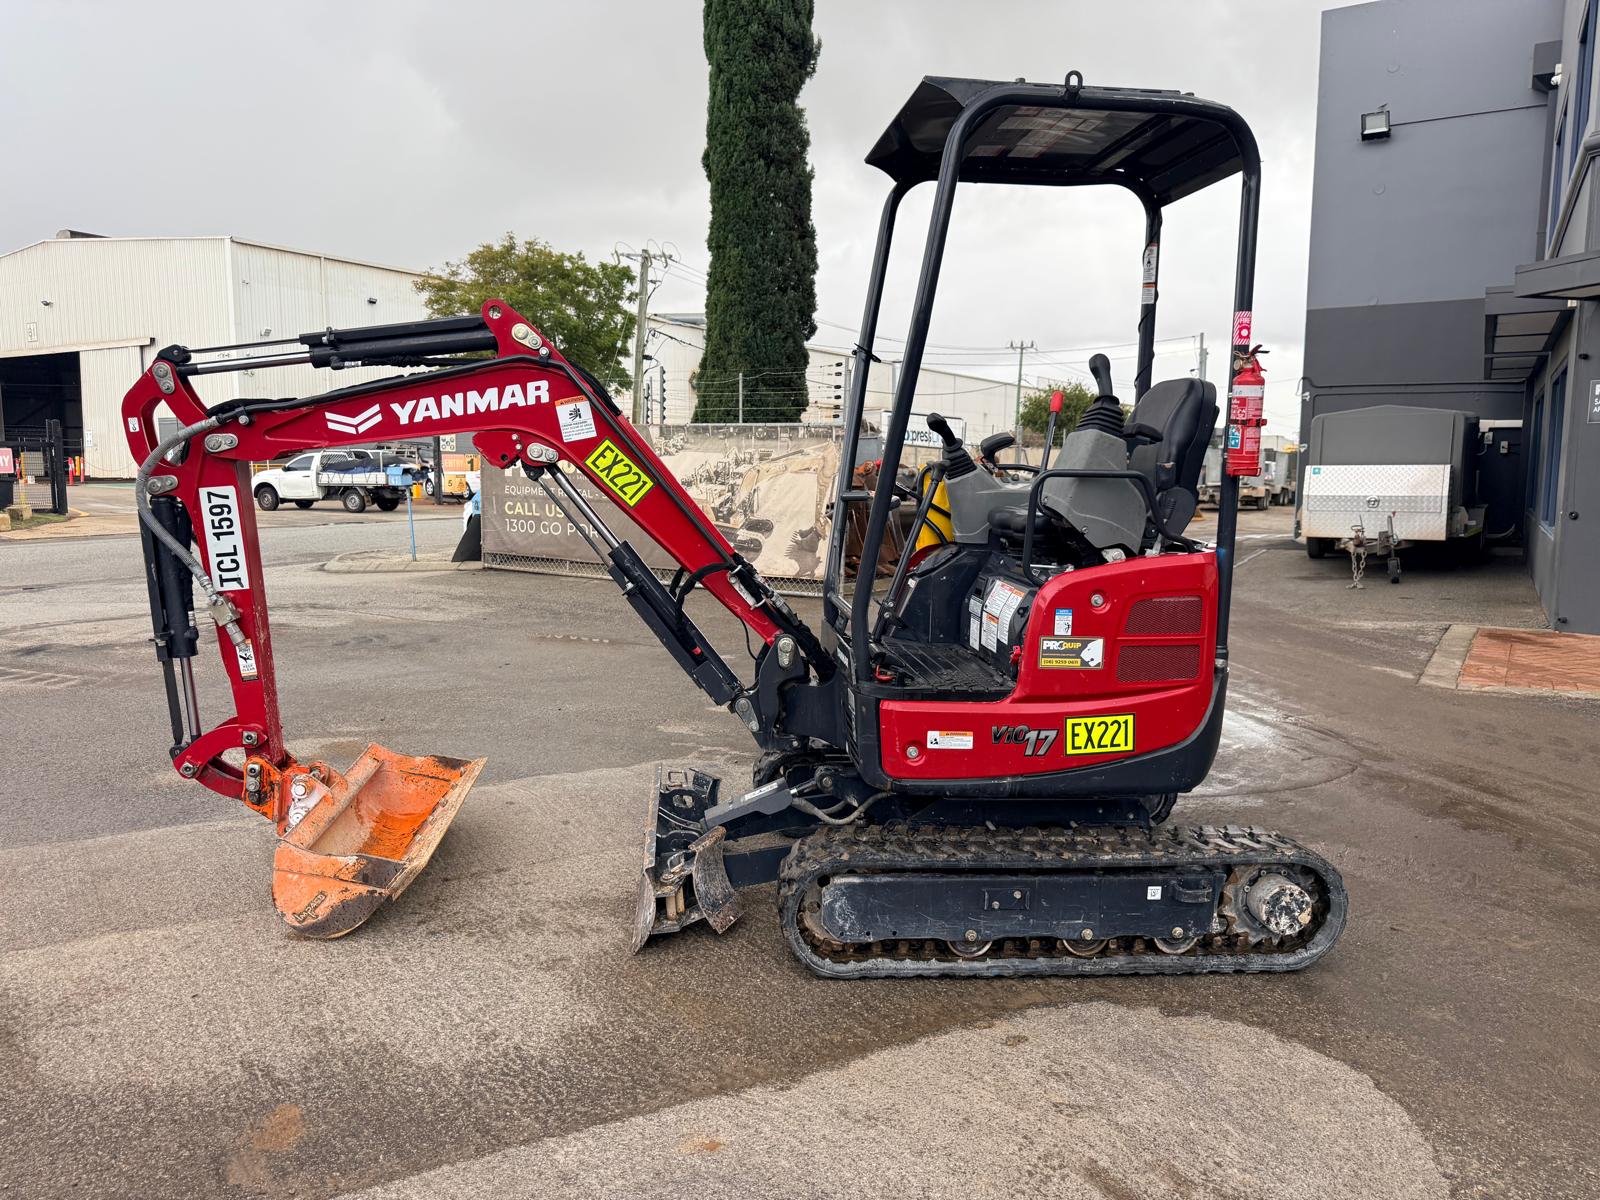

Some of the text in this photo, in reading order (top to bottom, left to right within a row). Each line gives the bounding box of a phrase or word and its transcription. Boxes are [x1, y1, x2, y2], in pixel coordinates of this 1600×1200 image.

[389, 379, 550, 425] YANMAR
[467, 458, 474, 471] 1
[591, 445, 648, 500] EX221
[557, 489, 594, 499] RTAL
[207, 491, 235, 541] 1597
[504, 501, 565, 518] CALL US
[505, 518, 536, 533] 1300
[540, 522, 562, 535] GO
[1071, 719, 1129, 751] EX221
